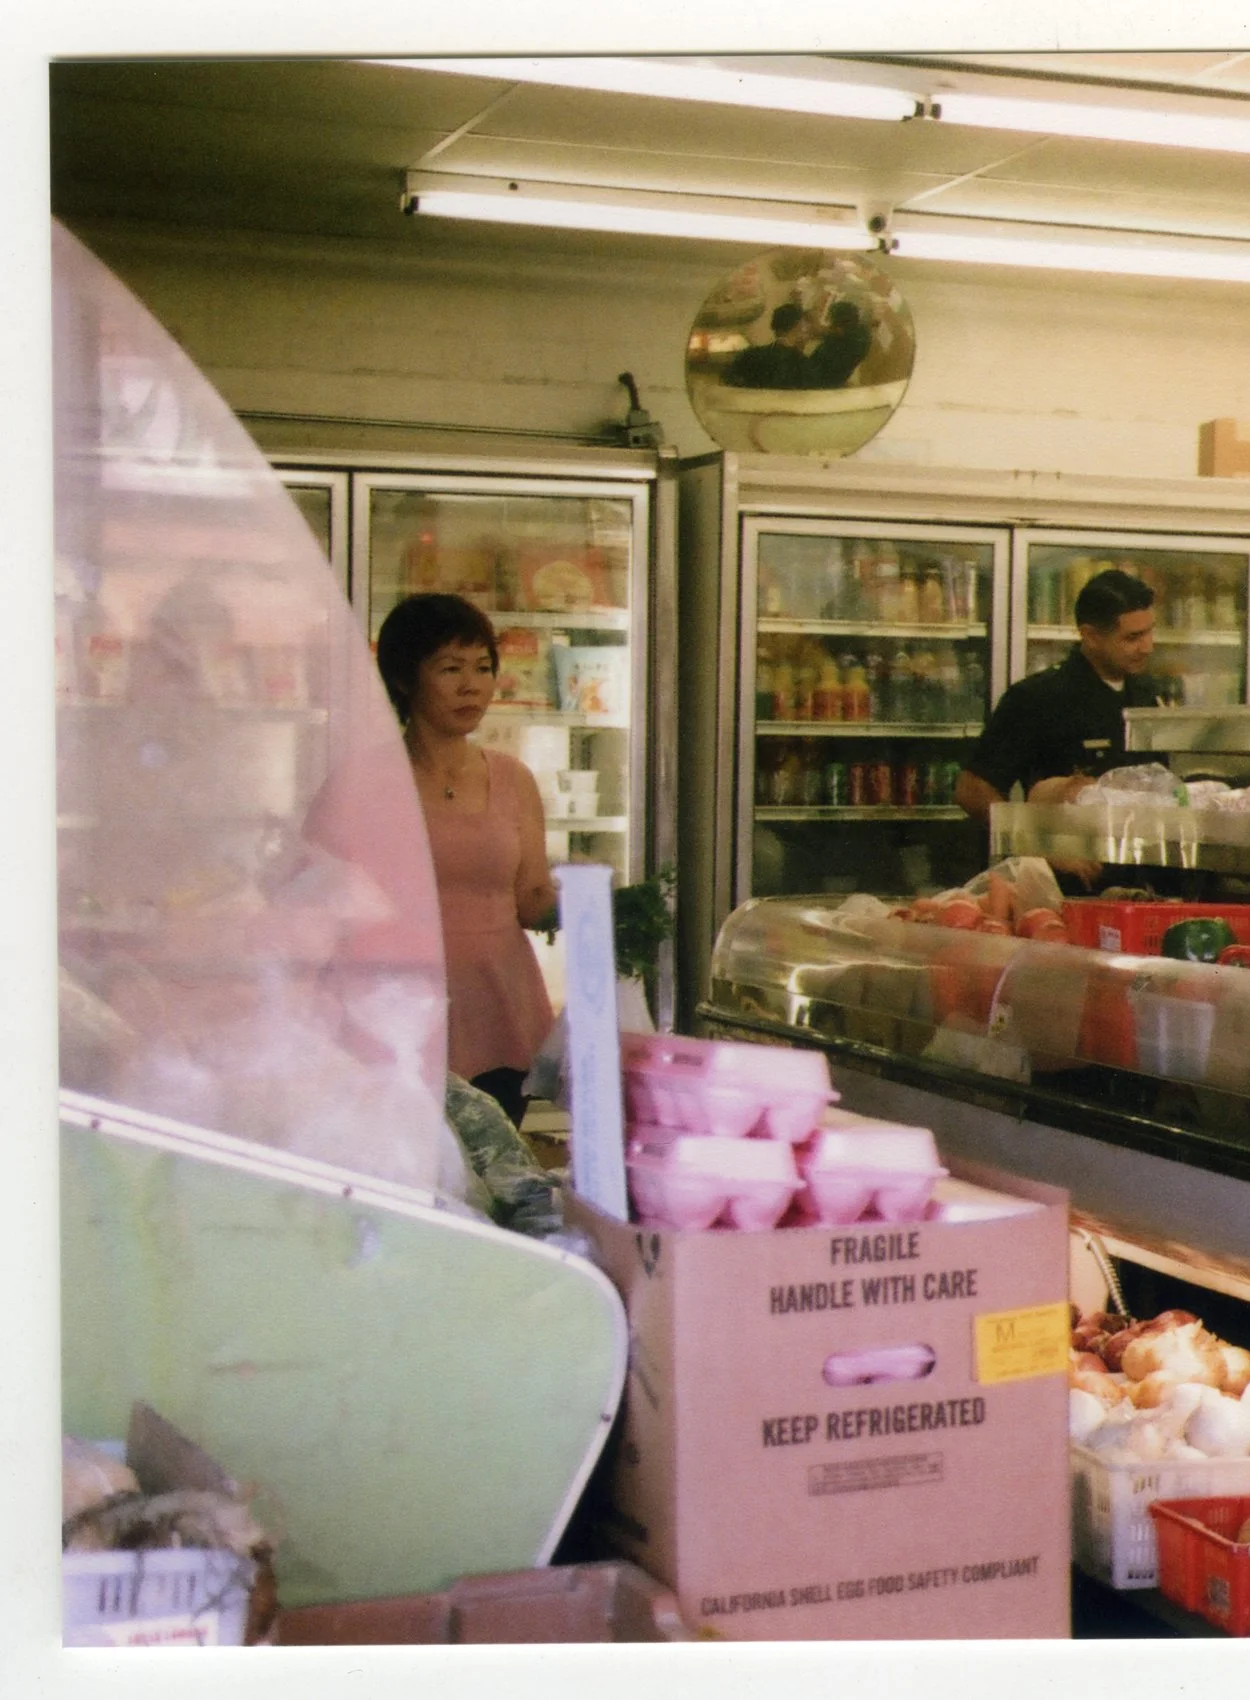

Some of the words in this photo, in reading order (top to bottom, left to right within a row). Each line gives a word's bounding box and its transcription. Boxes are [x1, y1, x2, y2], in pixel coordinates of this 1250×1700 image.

[831, 1232, 920, 1265] FRAGILE
[770, 1280, 854, 1316] HANDLE
[861, 1275, 916, 1306] WITH
[923, 1268, 978, 1301] CARE
[762, 1415, 818, 1448] KEEP
[826, 1397, 985, 1441] REFRIGERATED
[702, 1590, 786, 1616] CALIFORNIA
[790, 1584, 832, 1606] SHELL
[837, 1580, 865, 1599] EGG
[868, 1575, 903, 1596] FOOD
[908, 1567, 959, 1591] SAFETY
[962, 1556, 1040, 1583] COMPLIANT
